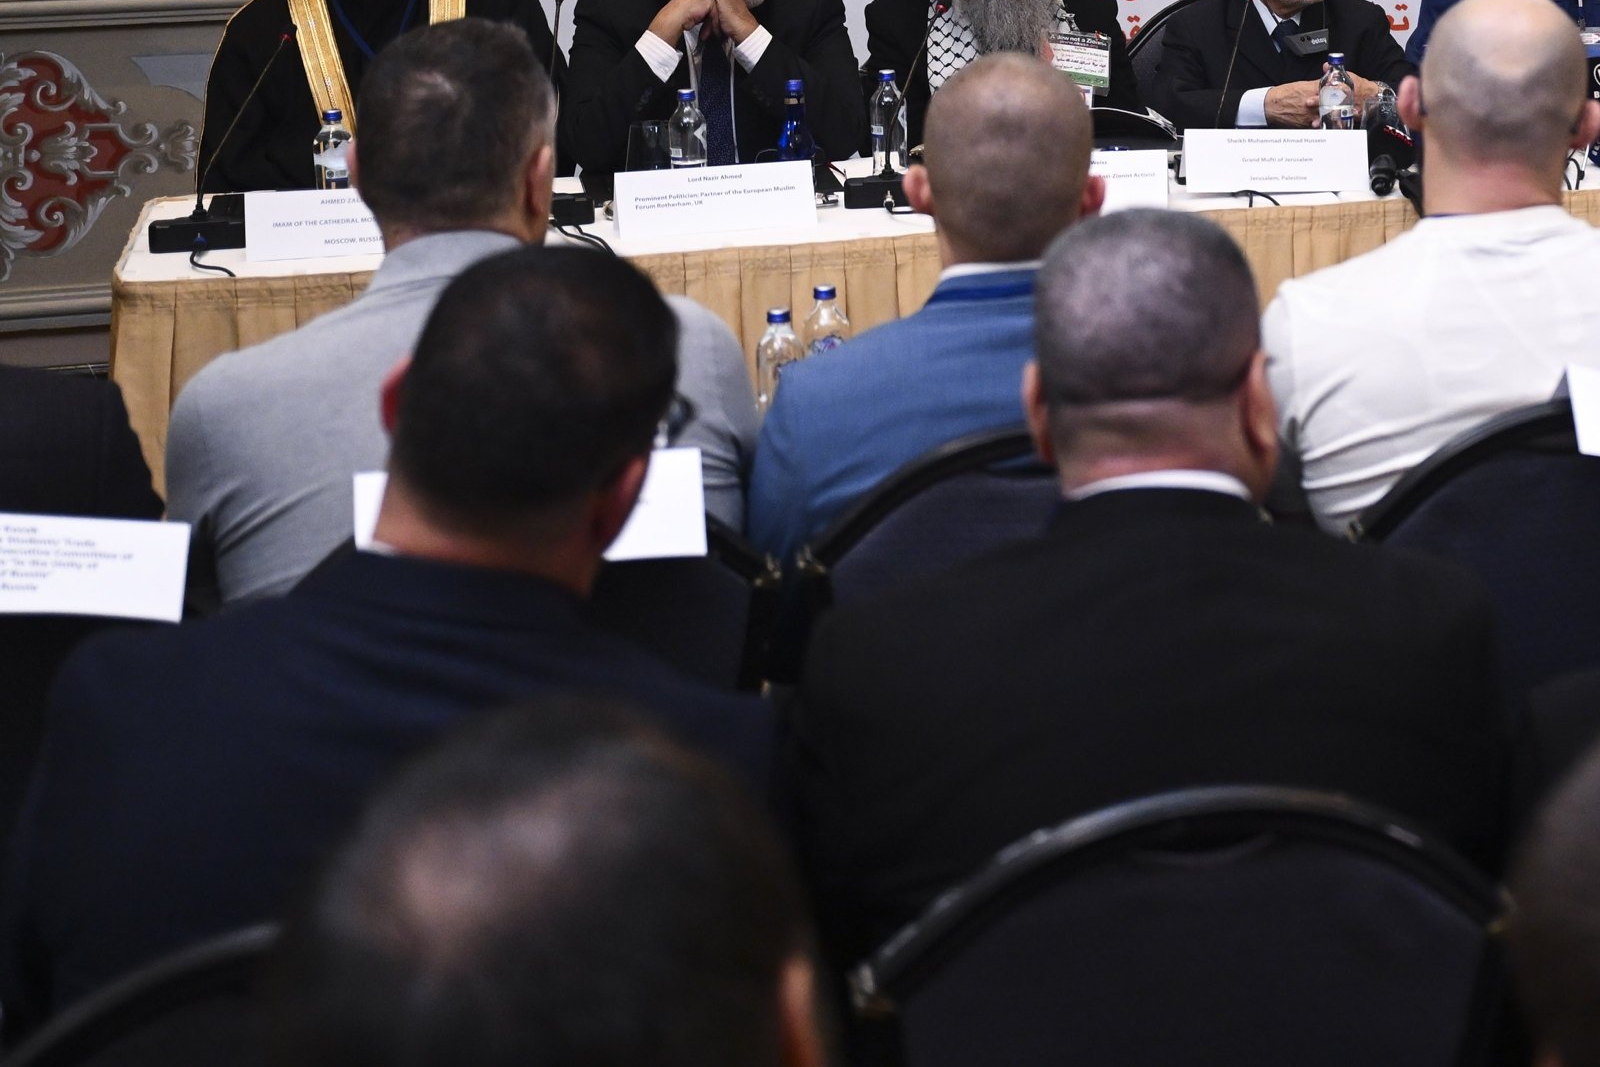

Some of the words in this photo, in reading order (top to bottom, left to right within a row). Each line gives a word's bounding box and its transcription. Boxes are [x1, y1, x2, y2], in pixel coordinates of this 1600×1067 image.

[1069, 35, 1081, 43] not
[1249, 174, 1281, 182] Jerusalem,
[320, 197, 346, 205] AHMED
[634, 195, 668, 203] Prominent
[656, 201, 694, 209] Rotherham,
[323, 237, 358, 245] MOSCOW,
